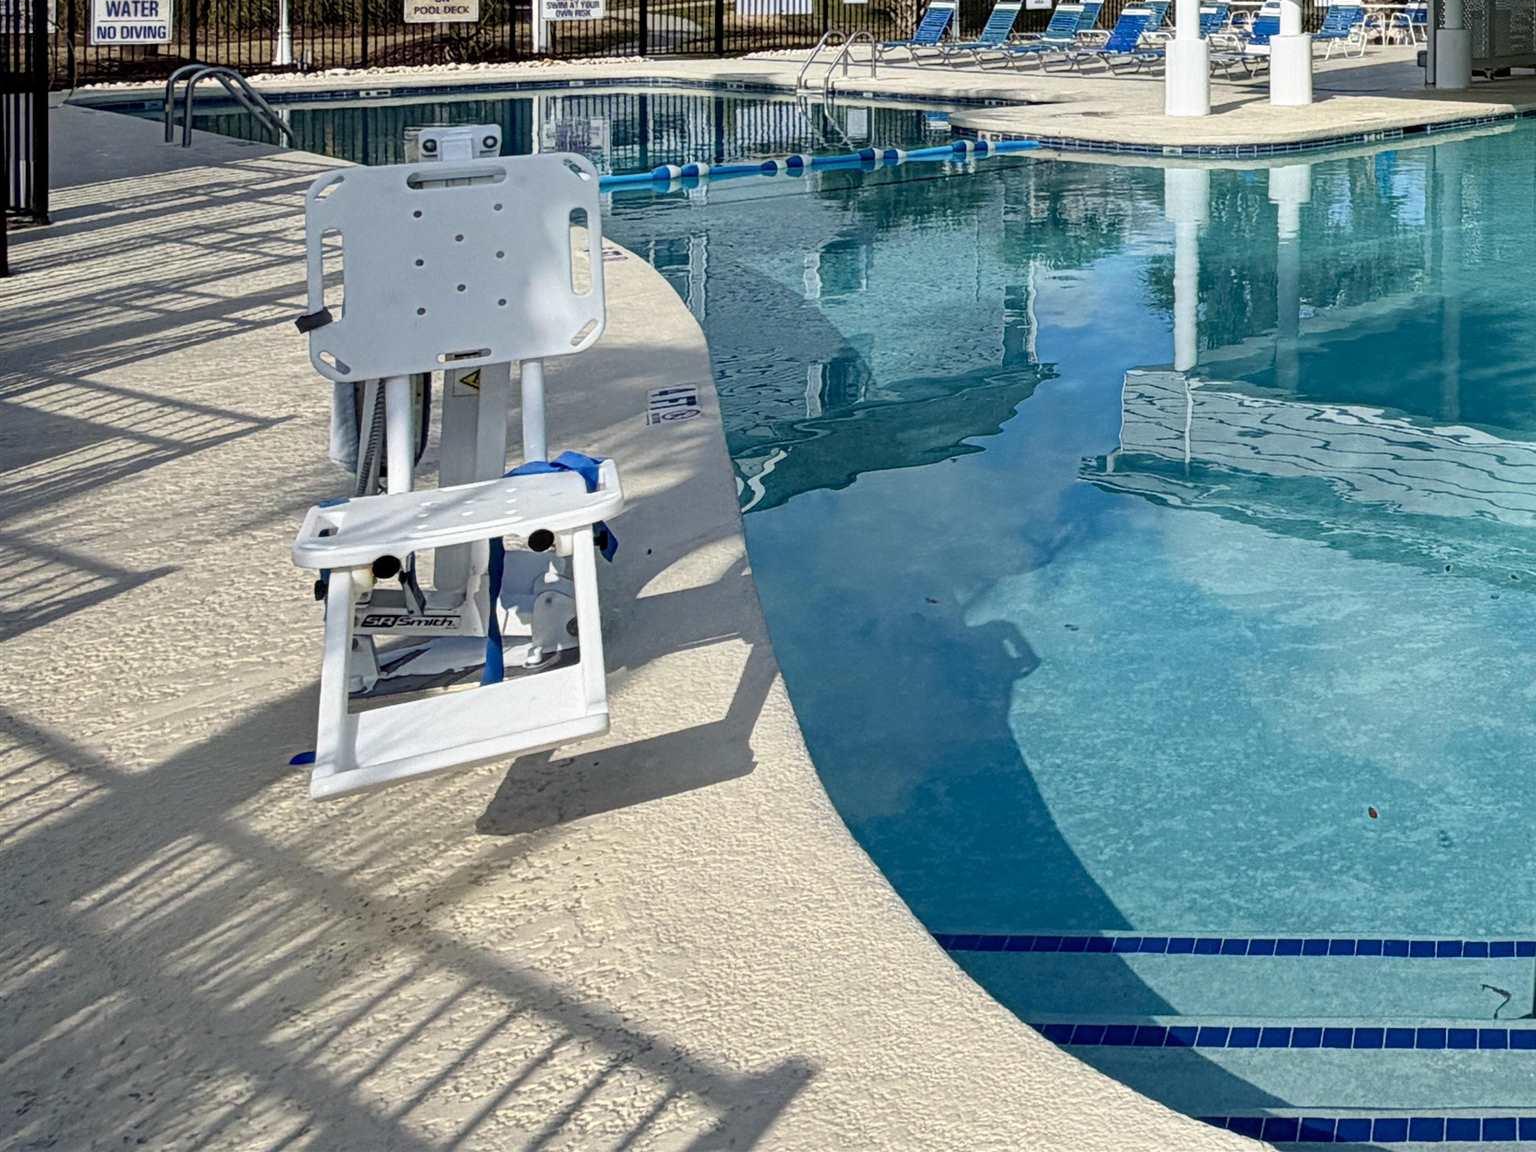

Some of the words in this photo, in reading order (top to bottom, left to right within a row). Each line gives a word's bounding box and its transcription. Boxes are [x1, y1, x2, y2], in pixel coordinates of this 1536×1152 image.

[106, 0, 159, 18] WATER
[414, 6, 440, 15] POOL
[443, 5, 469, 14] DECK
[97, 26, 117, 40] NO
[120, 25, 167, 40] DIVING
